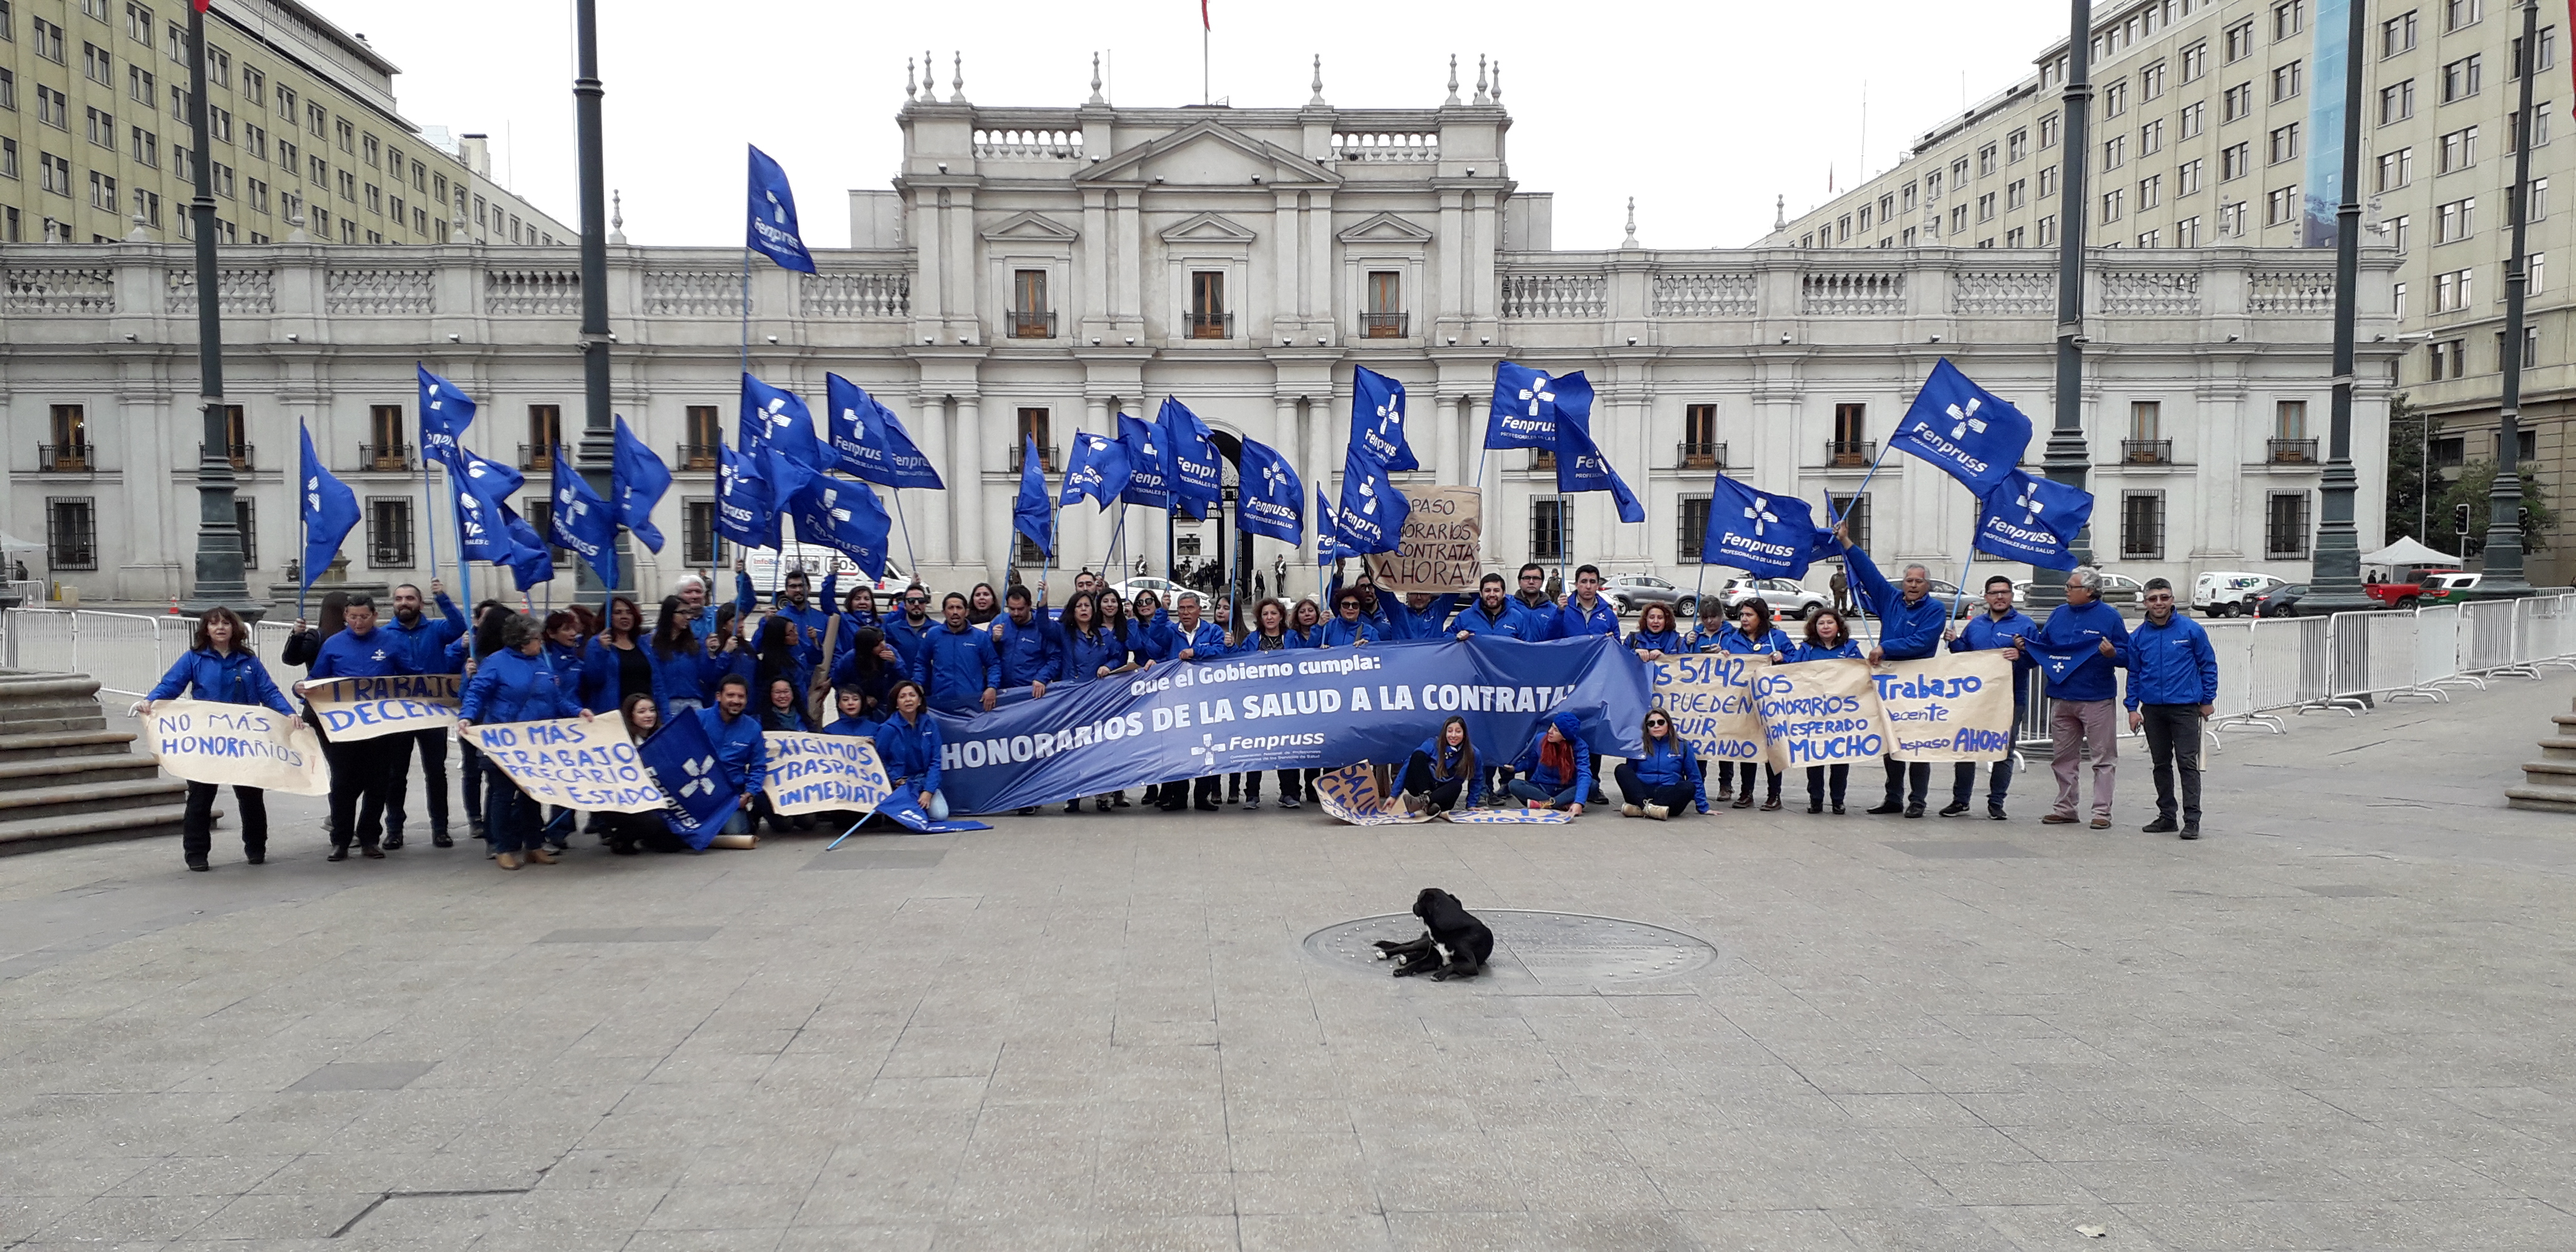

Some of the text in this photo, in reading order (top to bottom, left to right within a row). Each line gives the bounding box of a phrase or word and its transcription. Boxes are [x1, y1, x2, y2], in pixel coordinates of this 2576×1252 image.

[836, 435, 882, 461] Fenprus
[1365, 428, 1397, 457] Fenprus
[1912, 421, 1989, 472] Fenpruss
[1247, 497, 1297, 521] Fenpruss
[1411, 499, 1455, 516] PASO
[1987, 513, 2057, 544] Fenpruss
[1722, 532, 1795, 557] Fenpruss
[2035, 547, 2056, 555] SALUD
[838, 559, 857, 570] OS
[1376, 559, 1480, 585] AHORA!!
[1130, 654, 1382, 697] Que el Gobierno cumpla:
[1679, 657, 1749, 687] 5.142
[1751, 675, 1793, 700] LOS
[1670, 693, 1753, 714] PUEDEN
[159, 712, 271, 734] NO MÁS
[481, 718, 586, 747] NO MÁS
[940, 712, 1144, 771] HONORARIOS
[1152, 703, 1192, 733] DE
[1199, 698, 1236, 725] LA
[1242, 688, 1342, 720] SALUD
[1350, 687, 1372, 712] A
[1379, 685, 1415, 711] LA
[1672, 718, 1717, 738] GUIR
[1229, 732, 1325, 750] Fenpruss
[1692, 739, 1758, 758] RANDO
[1788, 734, 1881, 763] MUCHO
[1953, 727, 2009, 752] AHORA
[489, 742, 636, 767] TRABAJO
[504, 765, 638, 783] PRECARIO
[766, 758, 884, 786] TRASPASO
[567, 785, 662, 806] ESTADO
